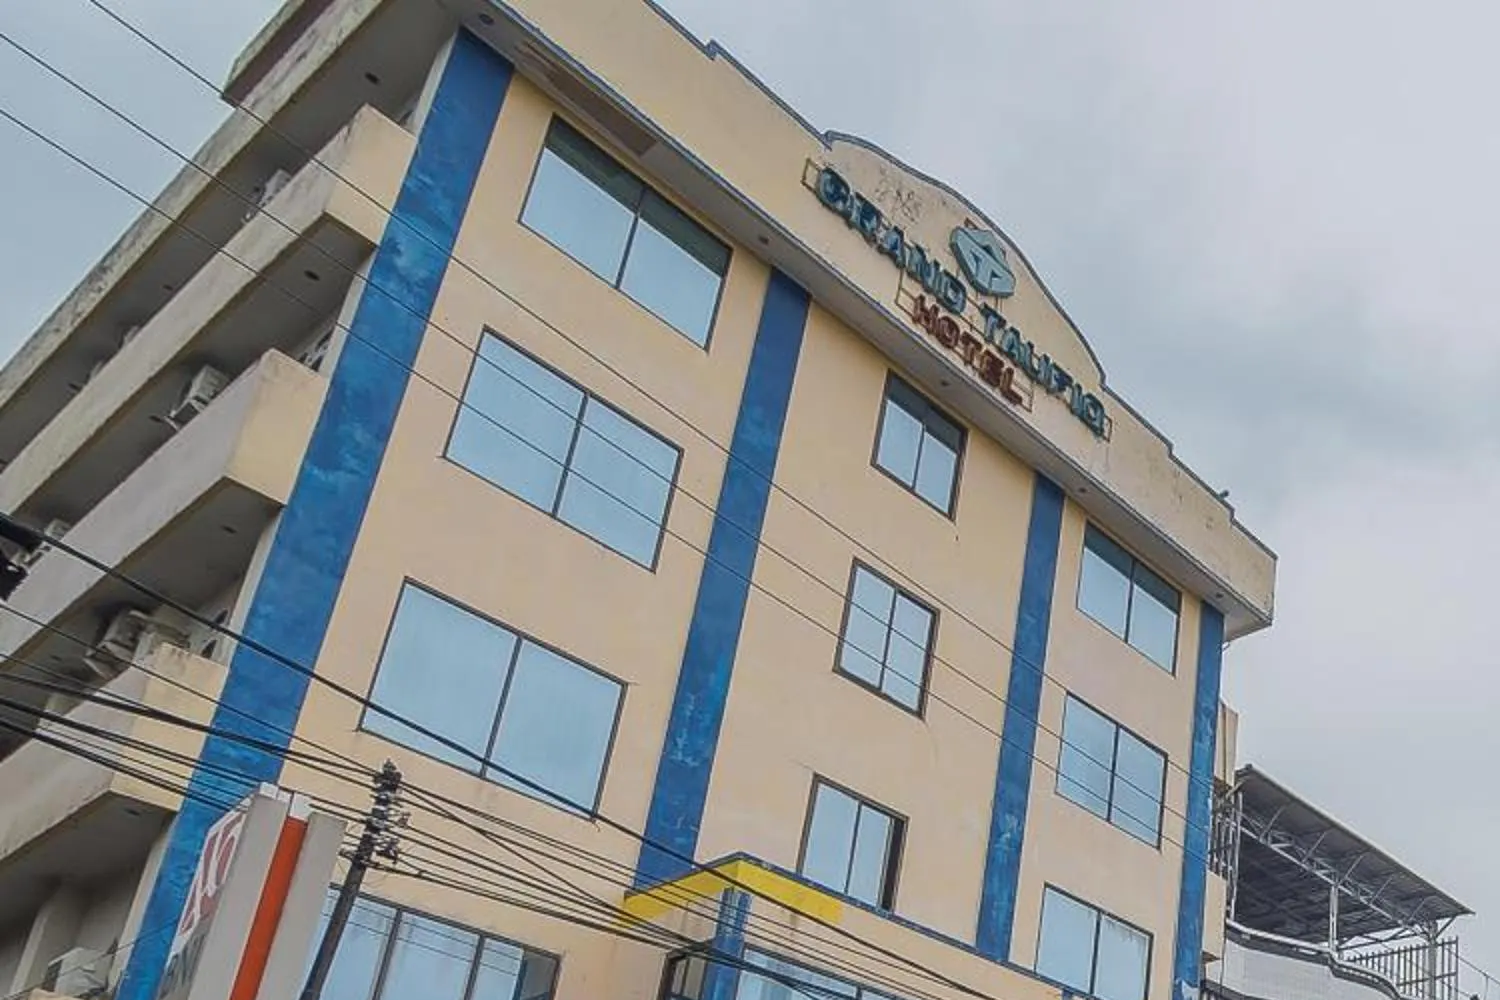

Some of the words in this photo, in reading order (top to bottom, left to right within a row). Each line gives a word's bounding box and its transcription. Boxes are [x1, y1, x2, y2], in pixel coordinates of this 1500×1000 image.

[816, 167, 967, 316] GRAND
[980, 303, 1106, 438] TAUFIQ
[911, 295, 1023, 405] HOTEL
